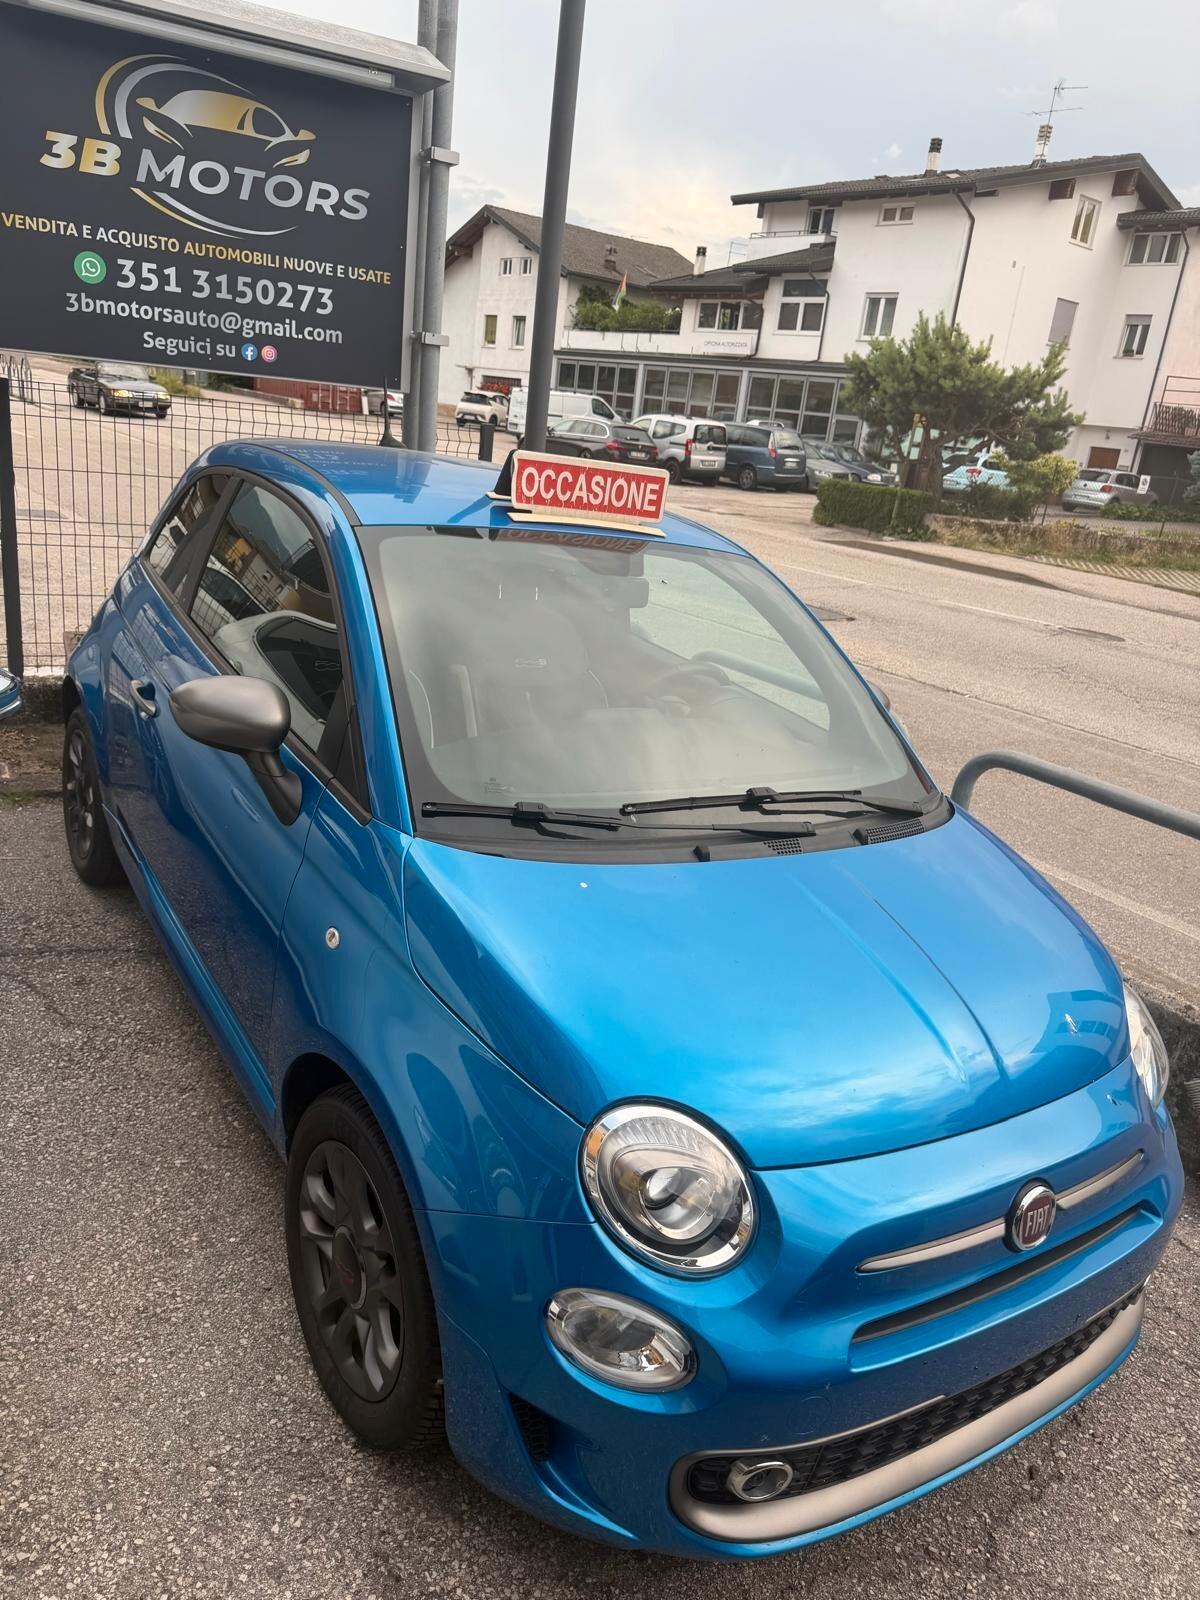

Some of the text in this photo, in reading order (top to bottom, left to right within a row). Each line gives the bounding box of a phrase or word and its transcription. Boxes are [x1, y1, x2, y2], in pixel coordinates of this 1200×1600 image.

[39, 130, 370, 220] 3B MOTORS
[1, 212, 391, 285] VENDITA E ACQUISTO AUTOMOBILI NUOVE E USATE
[116, 258, 334, 315] 351 3150273
[65, 292, 343, 344] 3bmotorsauto@gmail.com
[143, 332, 211, 355] Seguici
[216, 343, 236, 357] su
[521, 466, 659, 512] OCCASIONE
[1025, 1204, 1050, 1238] FIAT
